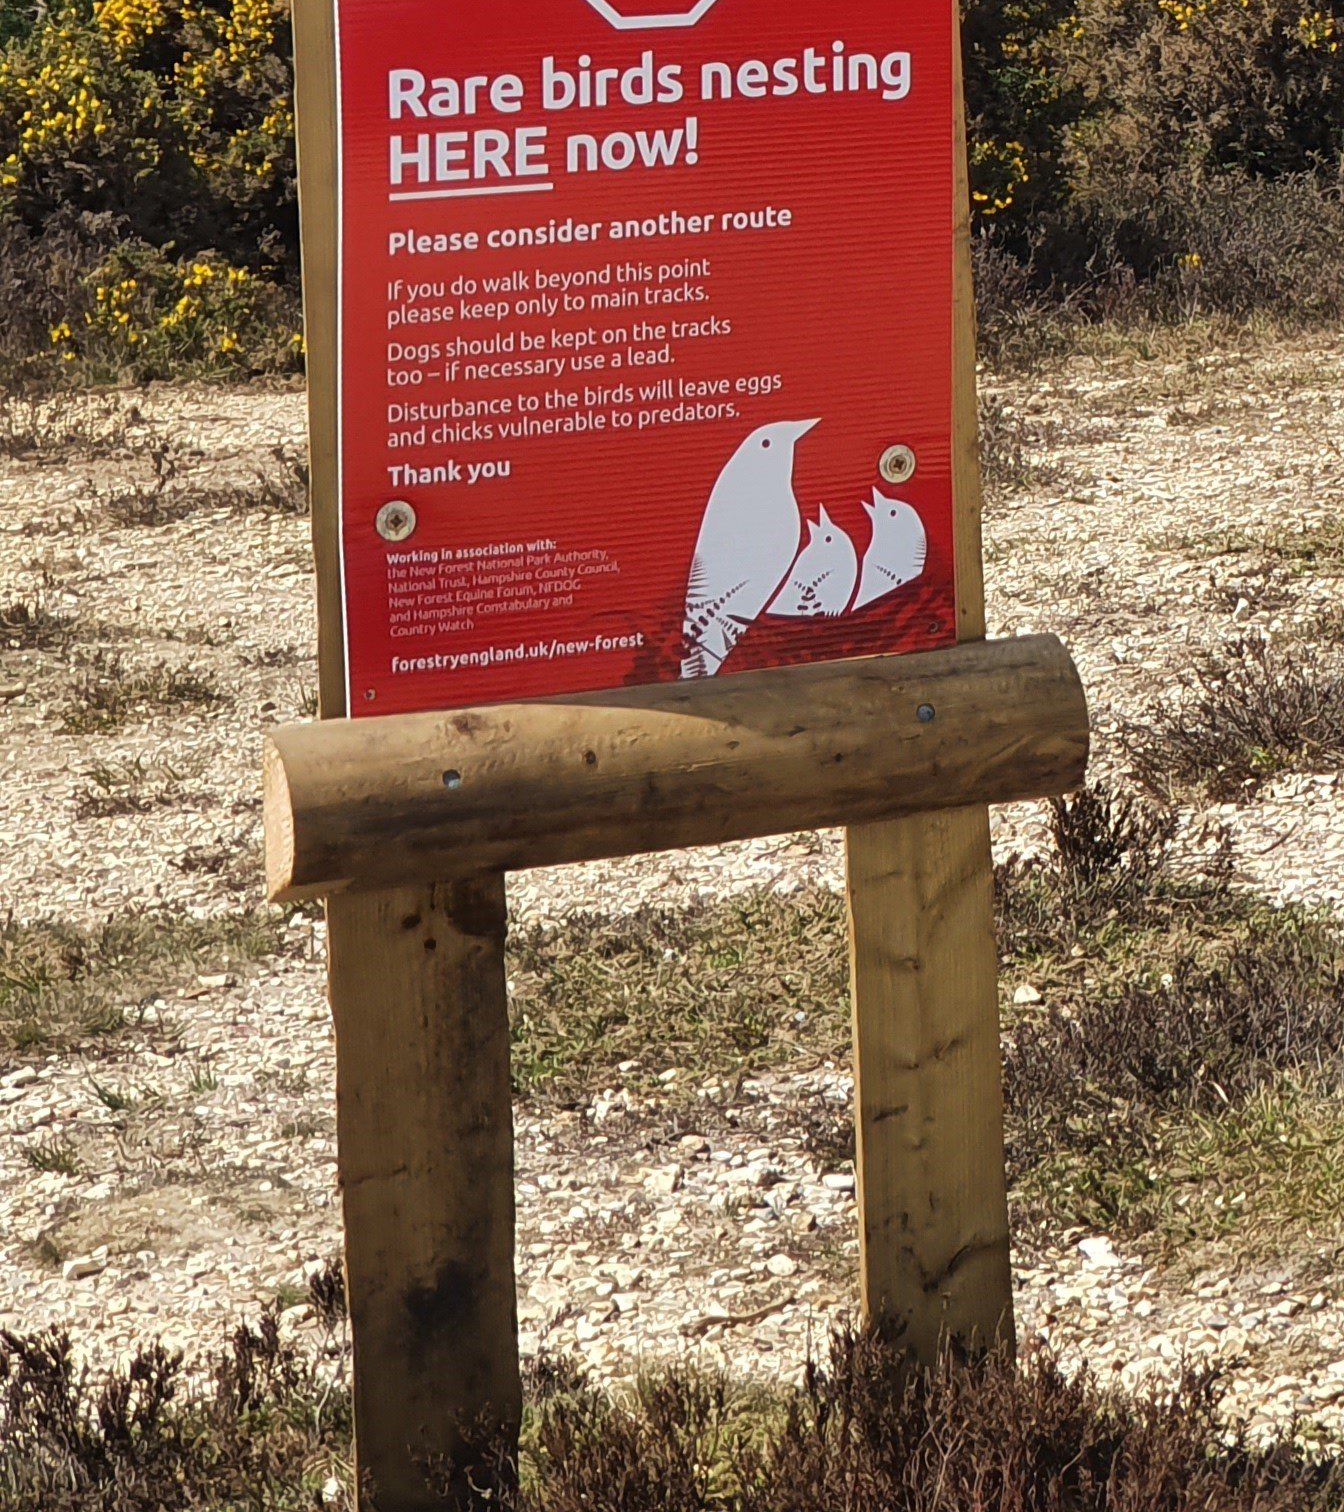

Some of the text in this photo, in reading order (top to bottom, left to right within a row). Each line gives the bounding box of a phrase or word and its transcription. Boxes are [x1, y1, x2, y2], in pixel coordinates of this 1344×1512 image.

[388, 40, 912, 120] Rare birds nesting
[389, 117, 700, 185] HERE now!
[389, 206, 792, 255] Please consider another route
[387, 258, 711, 303] If you do walk beyond this point
[387, 282, 709, 330] please keep only to main tracks.
[387, 315, 731, 364] Dogs should be kept on the tracks
[387, 368, 422, 386] too
[445, 361, 460, 381] if
[465, 358, 565, 380] necessary
[571, 355, 605, 370] use
[611, 353, 621, 367] a
[627, 343, 675, 366] lead.
[387, 374, 782, 423] Disturbance to the birds will leave eggs
[387, 402, 740, 447] and chicks vulnerable to predators.
[387, 459, 510, 486] Thank you
[387, 539, 556, 564] Working in association with:
[388, 549, 609, 579] the New Forest National Park Authority,
[389, 561, 621, 593] National Trust, Hampshire County Council,
[389, 597, 415, 608] New
[418, 592, 453, 605] Forest
[456, 587, 494, 603] Equine
[390, 610, 410, 623] and
[413, 602, 473, 619] Hampshire
[552, 594, 573, 606] and
[390, 619, 474, 637] Country Watch
[391, 631, 645, 673] forestryengland.uk/new-forest
